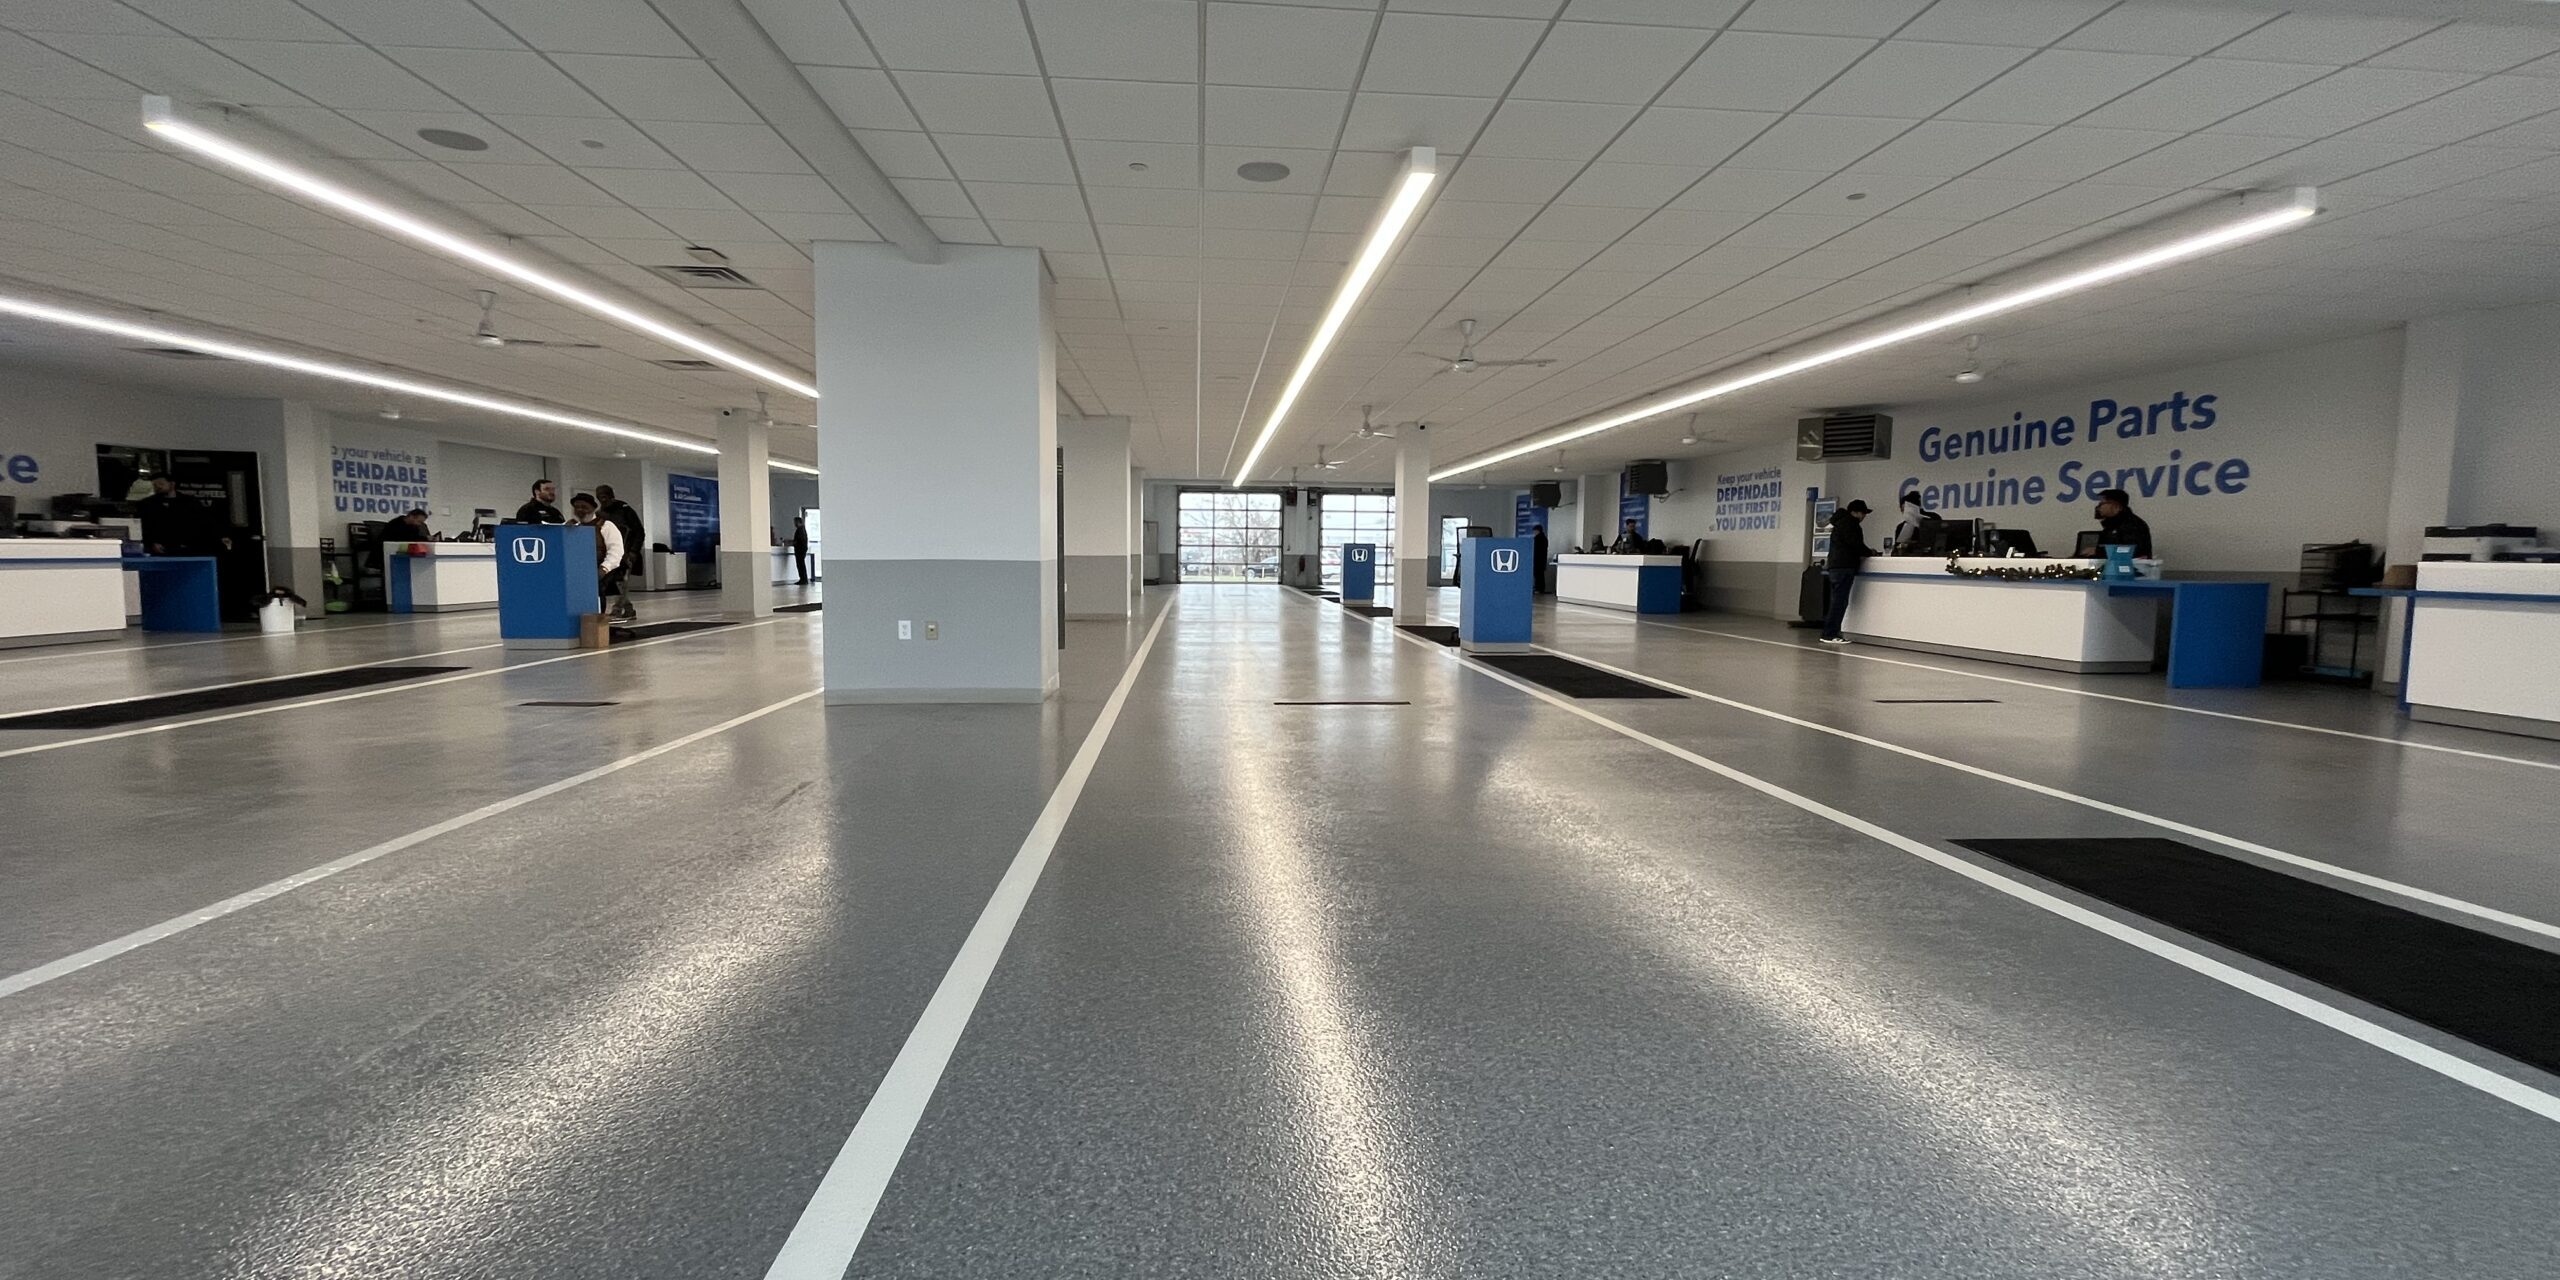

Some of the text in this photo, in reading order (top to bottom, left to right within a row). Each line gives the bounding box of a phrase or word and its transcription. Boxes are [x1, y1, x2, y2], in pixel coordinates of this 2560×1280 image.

[1919, 391, 2218, 463] Genuine Parts
[340, 447, 369, 460] your
[373, 448, 412, 464] vehicle
[415, 455, 427, 465] as
[1717, 466, 1782, 487] Keep your vehicle
[2056, 449, 2250, 503] Service
[362, 482, 399, 496] FIRST
[401, 485, 429, 498] DAY
[353, 496, 410, 514] DROVE
[1716, 504, 1726, 515] AS
[1728, 502, 1744, 514] THE
[1745, 501, 1770, 513] FIRST
[1716, 517, 1737, 531] YOU
[1739, 515, 1776, 530] DROVE
